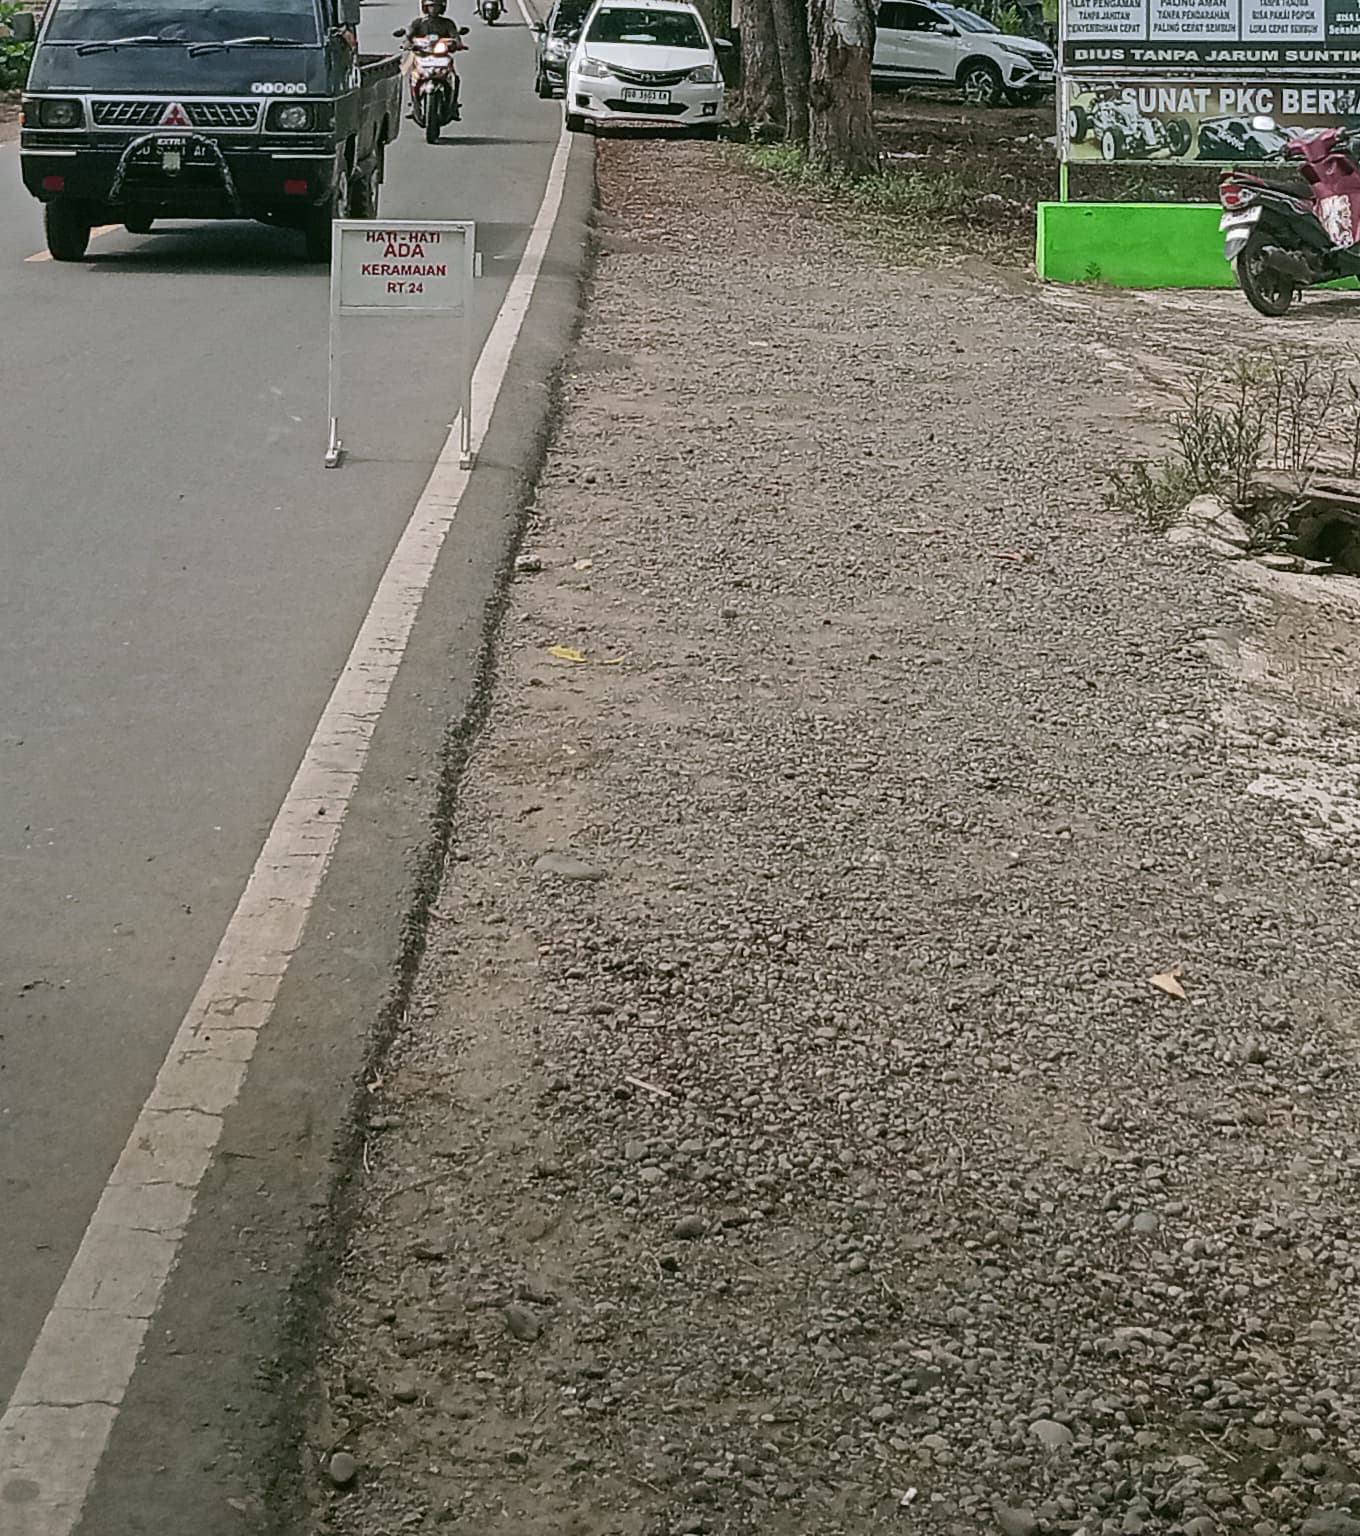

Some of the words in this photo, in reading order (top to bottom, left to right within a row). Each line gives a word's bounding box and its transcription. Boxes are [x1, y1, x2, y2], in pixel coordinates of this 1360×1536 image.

[1075, 49, 1125, 60] BIUS
[1130, 49, 1199, 61] TANPA
[1207, 50, 1279, 62] JARUM
[1121, 87, 1211, 113] SUNAT
[1219, 88, 1274, 114] PKC
[367, 232, 397, 243] HATI
[409, 232, 440, 243] HATI
[384, 244, 424, 258] ADA
[362, 264, 446, 276] KERAMAIAN
